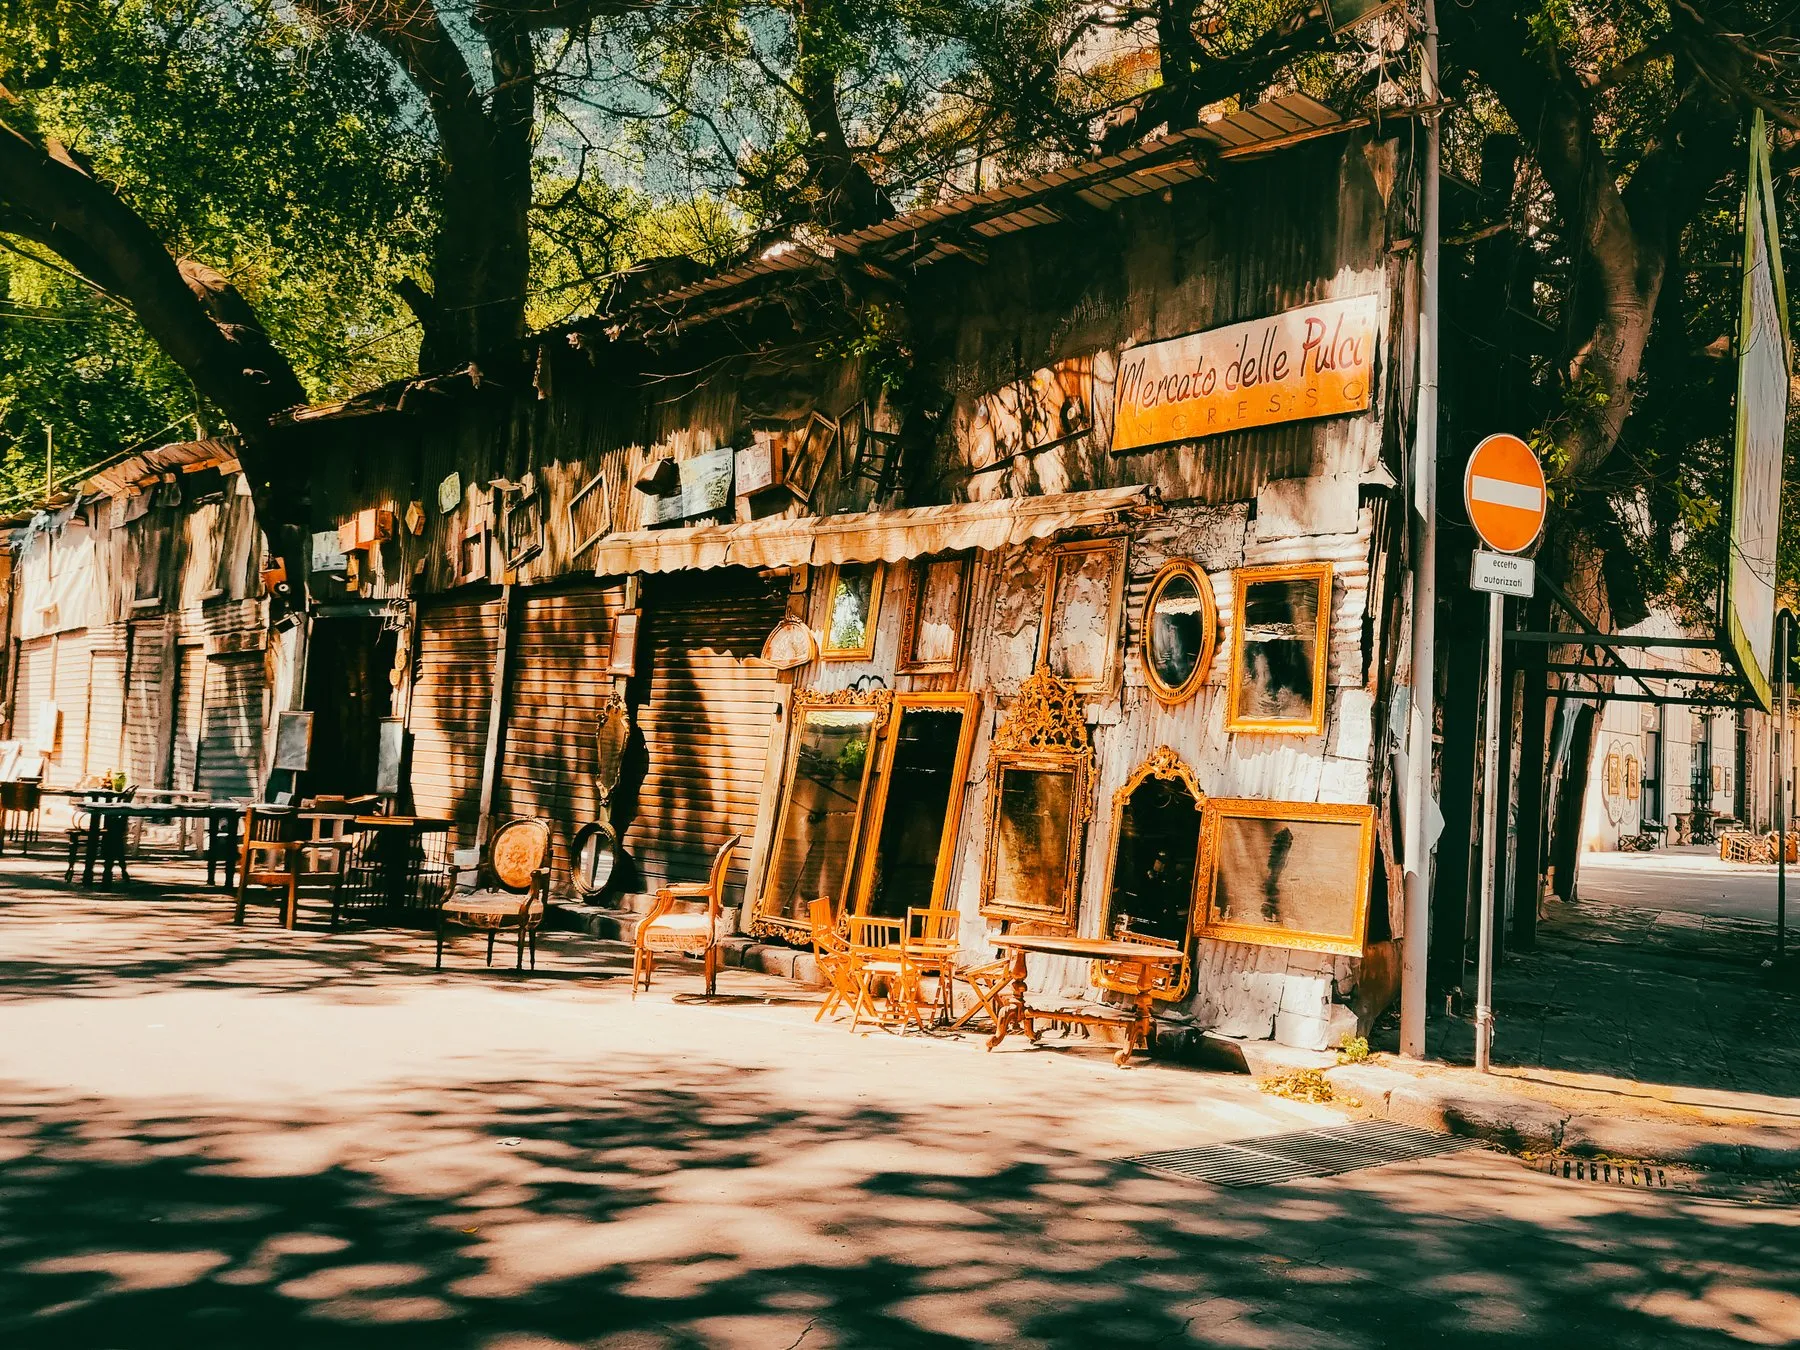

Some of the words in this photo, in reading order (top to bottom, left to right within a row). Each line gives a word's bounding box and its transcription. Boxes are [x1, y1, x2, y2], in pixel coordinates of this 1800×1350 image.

[1118, 356, 1217, 417] Mercato
[1225, 325, 1290, 391] delle
[1300, 312, 1367, 377] Pulci
[1492, 559, 1518, 570] eccetto
[1483, 576, 1523, 588] autorizzati
